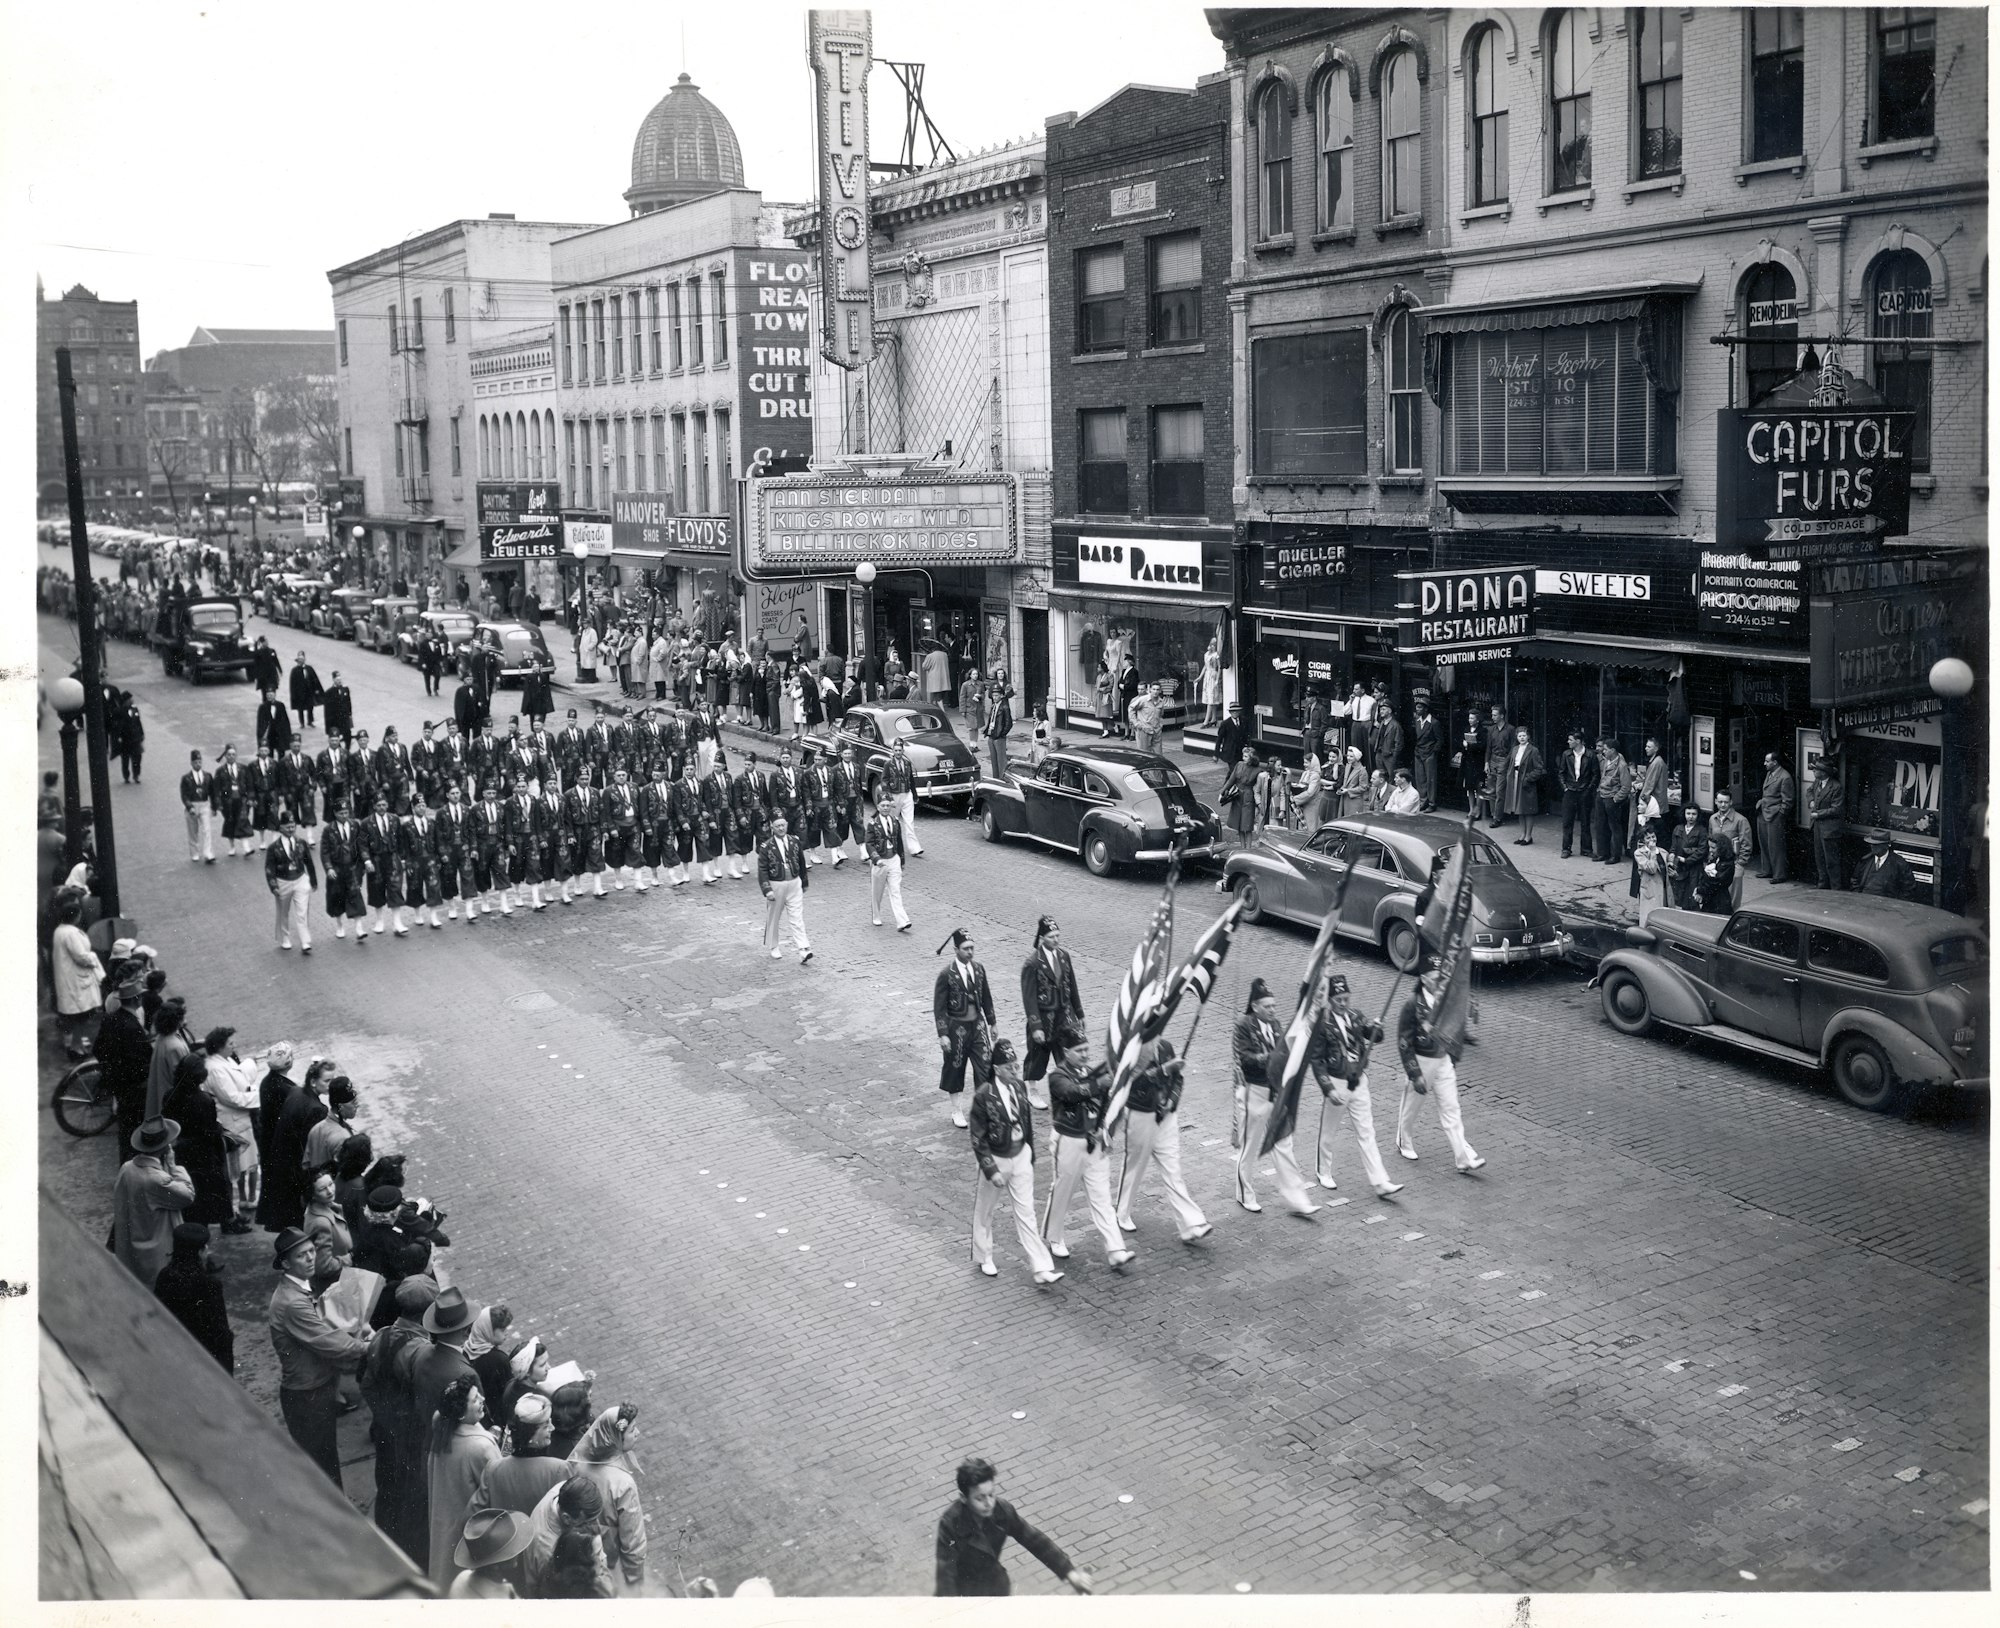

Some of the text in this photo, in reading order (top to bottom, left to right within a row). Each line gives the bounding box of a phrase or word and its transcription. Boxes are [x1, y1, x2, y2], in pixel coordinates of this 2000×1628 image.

[824, 41, 869, 355] TIVOLI
[750, 313, 781, 331] TO
[1488, 354, 1538, 378] Herbert
[748, 373, 798, 393] CUT
[1509, 378, 1576, 394] STUIO
[1747, 418, 1903, 464] CAPITOL
[819, 487, 918, 505] SHERIDAN
[1776, 467, 1874, 514] FURS
[483, 494, 510, 509] DAYTIME
[616, 501, 666, 524] HANOVER
[775, 511, 833, 529] KINGS
[842, 510, 884, 528] ROW
[922, 509, 971, 527] WILD
[643, 529, 660, 543] SHOE
[668, 519, 728, 546] FLOYD'S
[1783, 519, 1865, 534] COLD STORAGE
[782, 532, 978, 551] BILL HICKOK RIDES
[1769, 546, 1786, 559] WALK
[1787, 545, 1796, 558] UP
[1802, 544, 1823, 557] FLIGHT
[1838, 542, 1854, 554] SAVE
[489, 545, 556, 558] JEWELERS
[1080, 544, 1123, 563] BABS
[1278, 545, 1346, 564] MUELLER
[1279, 563, 1323, 579] CIGAR
[1559, 572, 1647, 599] SWEETS
[1705, 575, 1799, 591] PORTRAITS COMMERCIAL
[1421, 574, 1528, 616] DIANA
[1700, 591, 1800, 613] PHOTOGRAPHY
[1421, 613, 1529, 642] RESTAURANT
[1435, 647, 1512, 665] FOUNTAIN SERVICE
[1308, 661, 1332, 671] CIGAR
[1308, 670, 1332, 680] STORE
[1744, 679, 1773, 695] CAPITOL
[1754, 692, 1783, 705] FURS
[1844, 709, 1877, 727] RETURNS
[1894, 704, 1909, 718] ALL
[1868, 724, 1915, 738] TAVERN
[1891, 759, 1941, 811] PM
